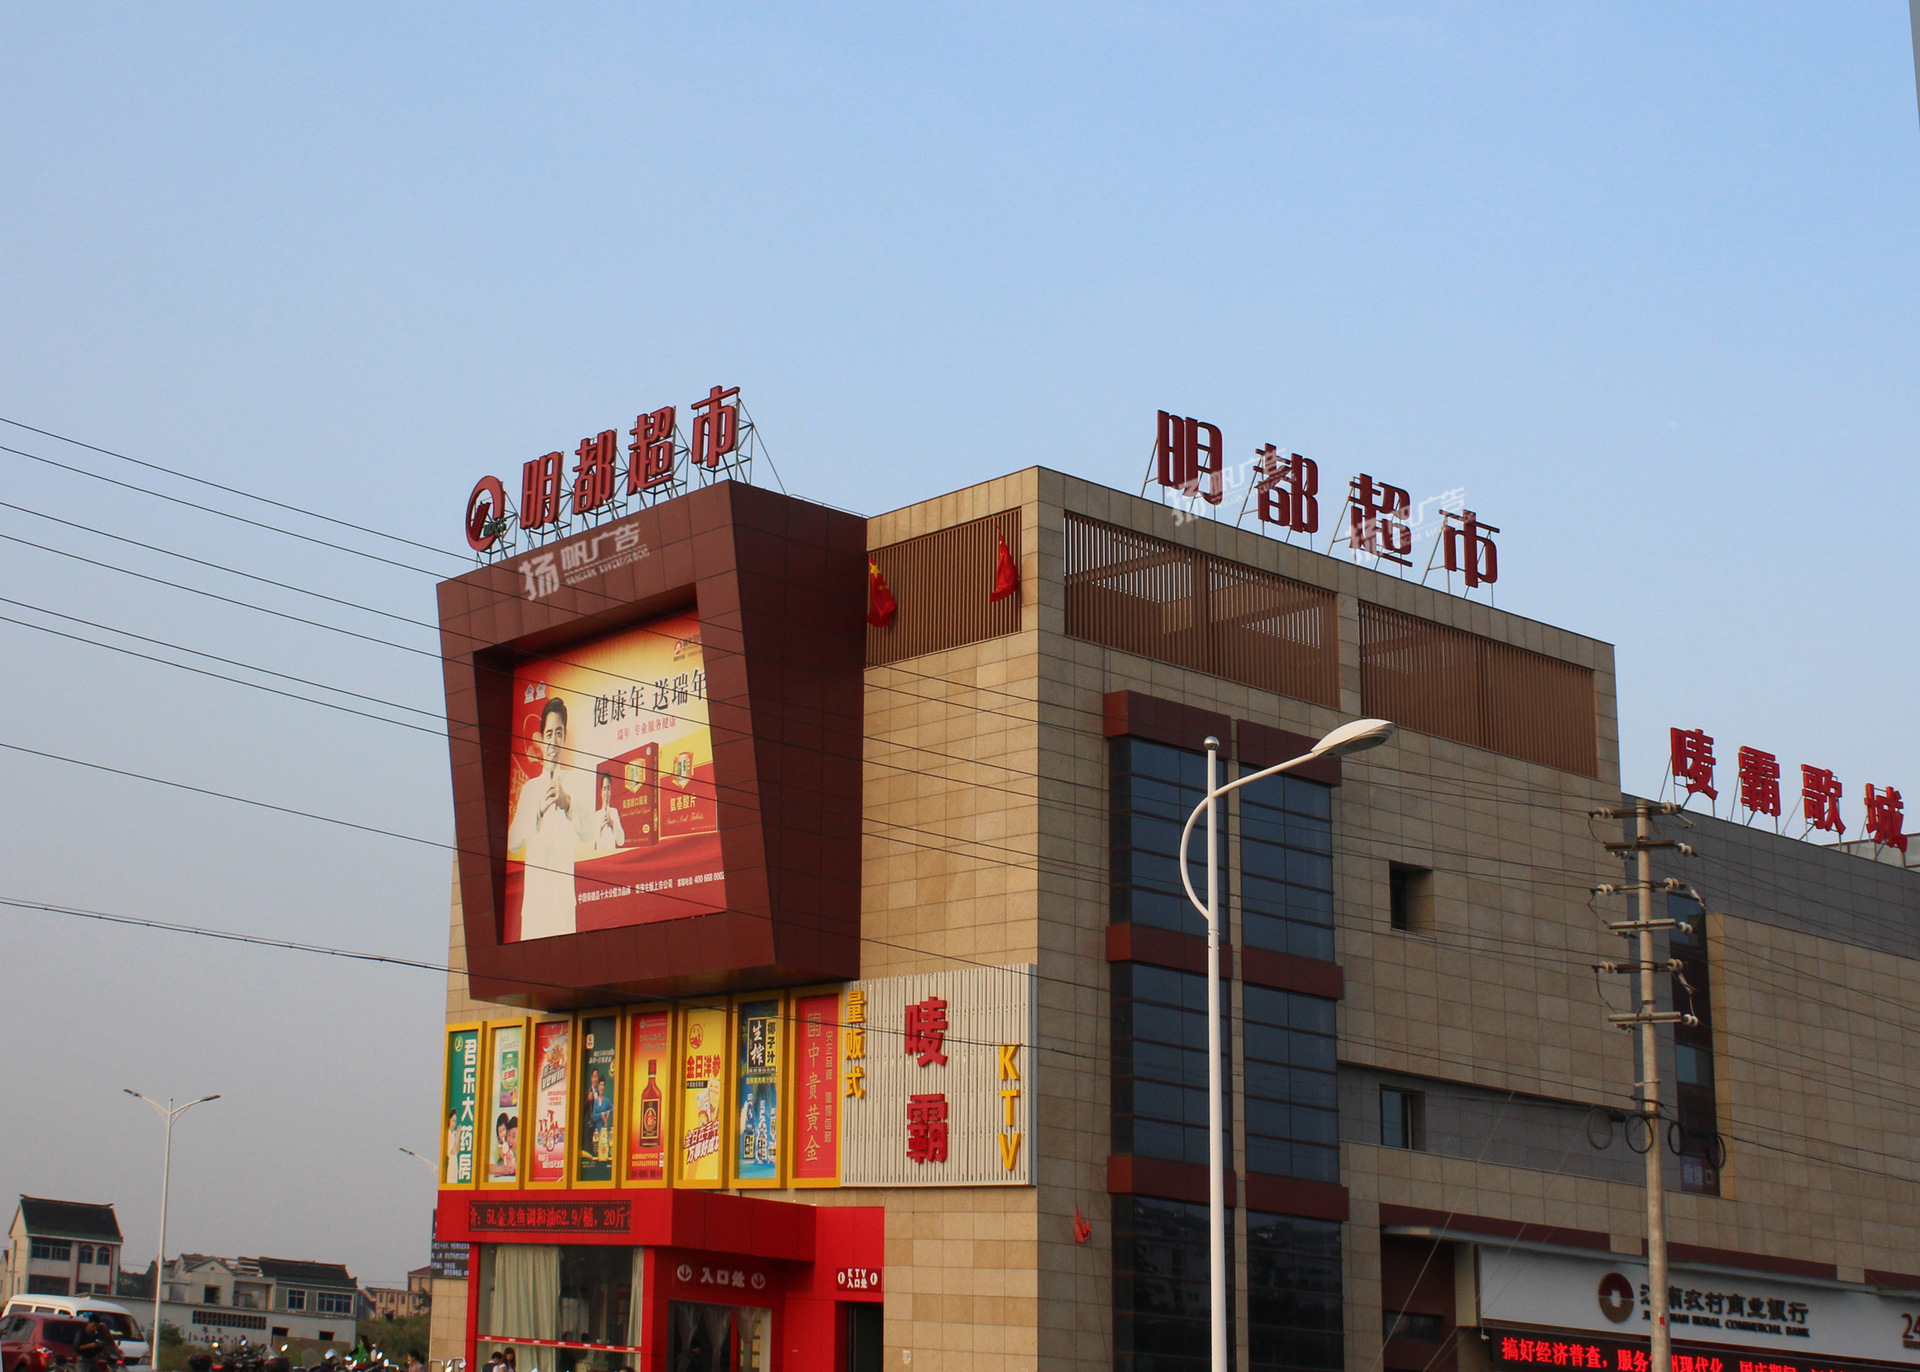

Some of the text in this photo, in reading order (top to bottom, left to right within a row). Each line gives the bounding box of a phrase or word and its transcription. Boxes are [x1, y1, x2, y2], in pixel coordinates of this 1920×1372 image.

[520, 385, 741, 530] 明都超市
[1157, 409, 1501, 589] 明都超市
[593, 668, 706, 728] 健康年 送瑞年
[844, 990, 867, 1099] 量贩式
[458, 1038, 477, 1180] 君乐大药房
[997, 1043, 1022, 1171] KTV
[700, 1267, 746, 1288] 入口处
[847, 1268, 867, 1278] KTV
[847, 1278, 868, 1289] 入口处
